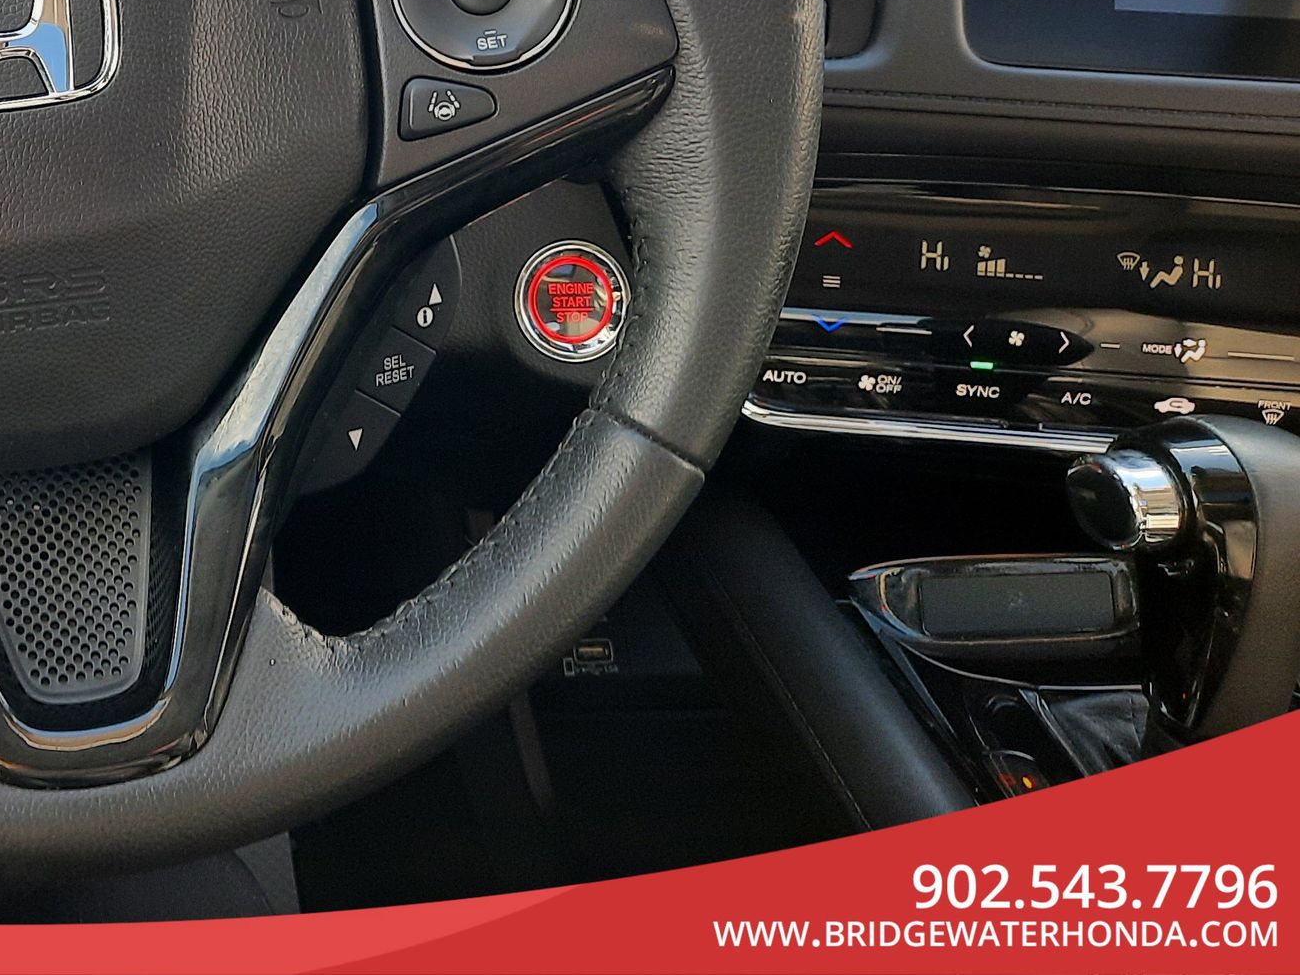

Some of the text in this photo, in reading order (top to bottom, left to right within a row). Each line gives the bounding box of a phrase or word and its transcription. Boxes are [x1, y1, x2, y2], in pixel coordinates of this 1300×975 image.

[477, 34, 507, 51] SET
[549, 282, 594, 295] ENGINE
[552, 296, 591, 308] START
[556, 311, 589, 323] STOP
[1142, 343, 1173, 355] MODE
[383, 354, 407, 371] SEL
[375, 365, 415, 387] RESET
[762, 369, 807, 385] AUTO
[875, 383, 903, 394] OFF
[955, 384, 1000, 399] SYNC
[1061, 391, 1092, 406] A/C
[1258, 400, 1292, 411] FRONT
